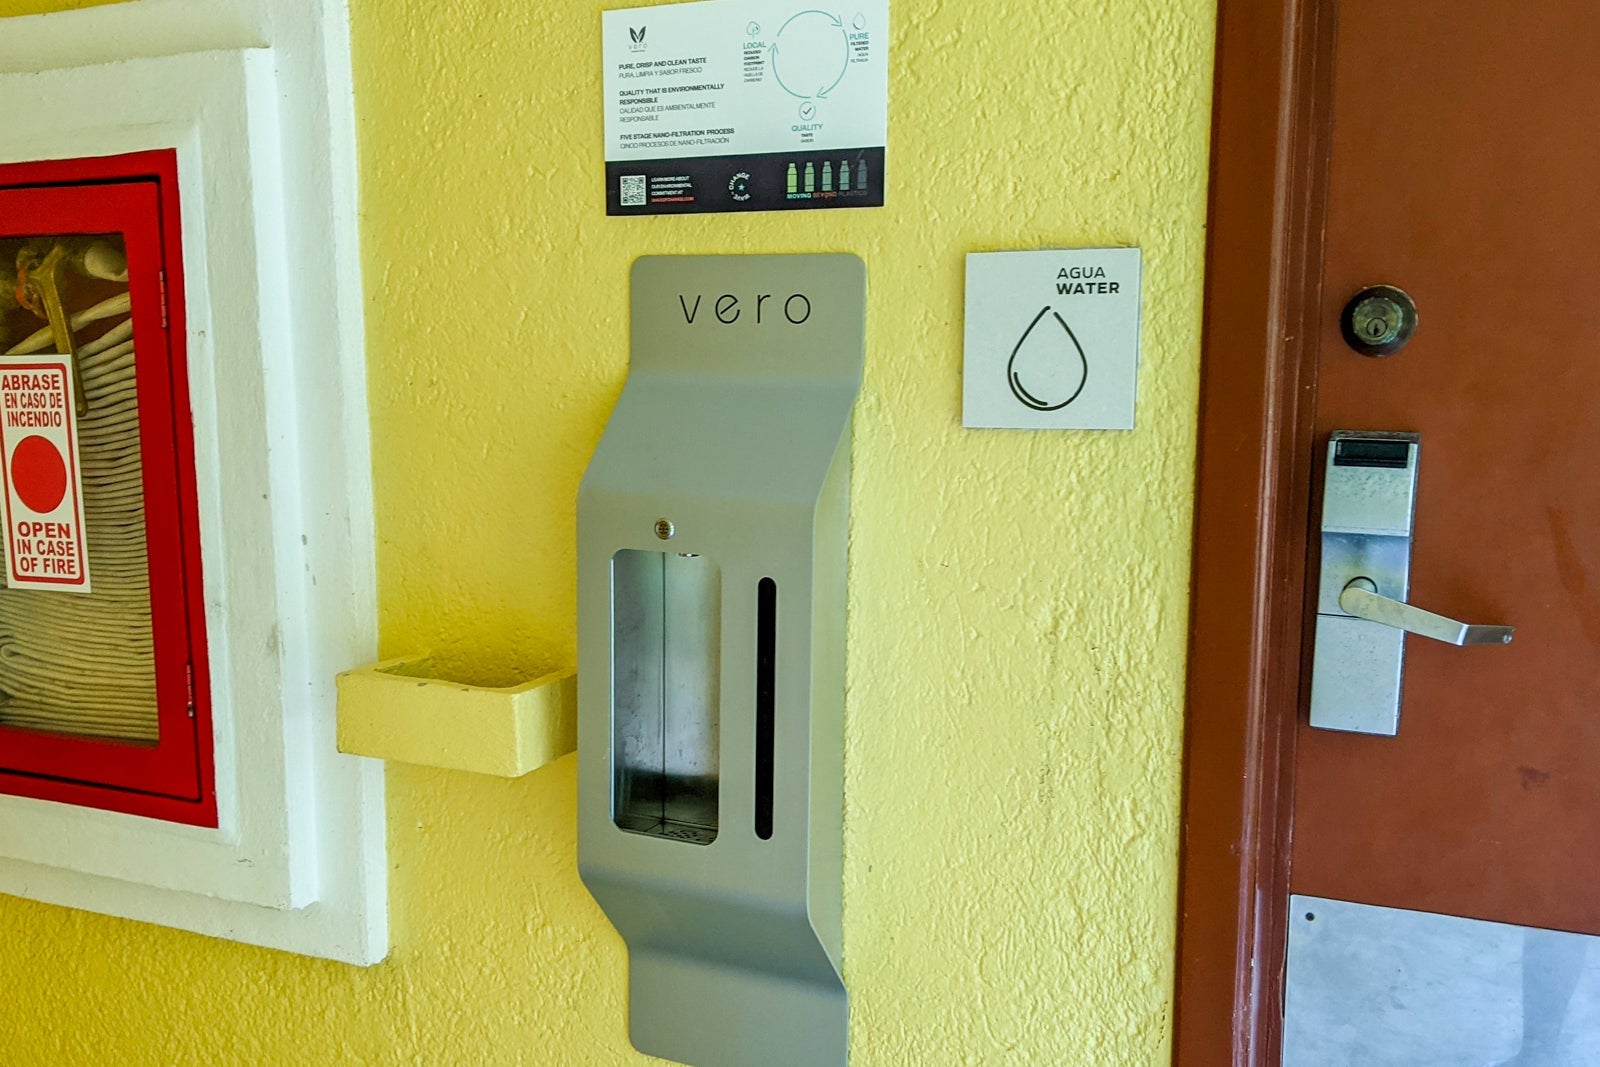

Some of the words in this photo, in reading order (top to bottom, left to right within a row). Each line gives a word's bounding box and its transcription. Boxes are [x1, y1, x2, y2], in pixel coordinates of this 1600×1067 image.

[850, 32, 870, 40] PURE
[743, 41, 766, 49] LOCAL
[636, 61, 653, 69] CRISP
[679, 66, 703, 74] FRESCO
[619, 89, 644, 97] QUALITY
[668, 83, 725, 93] ENVIRONMENTALLY
[619, 97, 658, 105] RESPONSIBLE
[619, 106, 643, 114] CALIDAD
[665, 101, 716, 111] AMBIENTALMENTE
[619, 115, 659, 123] RESPONSABLE
[653, 129, 705, 138] NANO-FILTRATION
[706, 127, 735, 135] PROCESS
[791, 123, 824, 132] QUALITY
[639, 140, 669, 148] PROCESOS
[1057, 266, 1107, 280] AGUA
[1056, 281, 1120, 295] WATER
[679, 294, 812, 324] vero
[2, 374, 60, 391] ABRASE
[5, 392, 18, 409] EN
[20, 392, 47, 409] CASO
[50, 392, 63, 409] DE
[7, 410, 62, 428] INCENDIO
[17, 521, 71, 539] OPEN
[17, 539, 32, 555] IN
[36, 539, 75, 557] CASE
[20, 557, 38, 573] OF
[43, 558, 76, 575] FIRE
